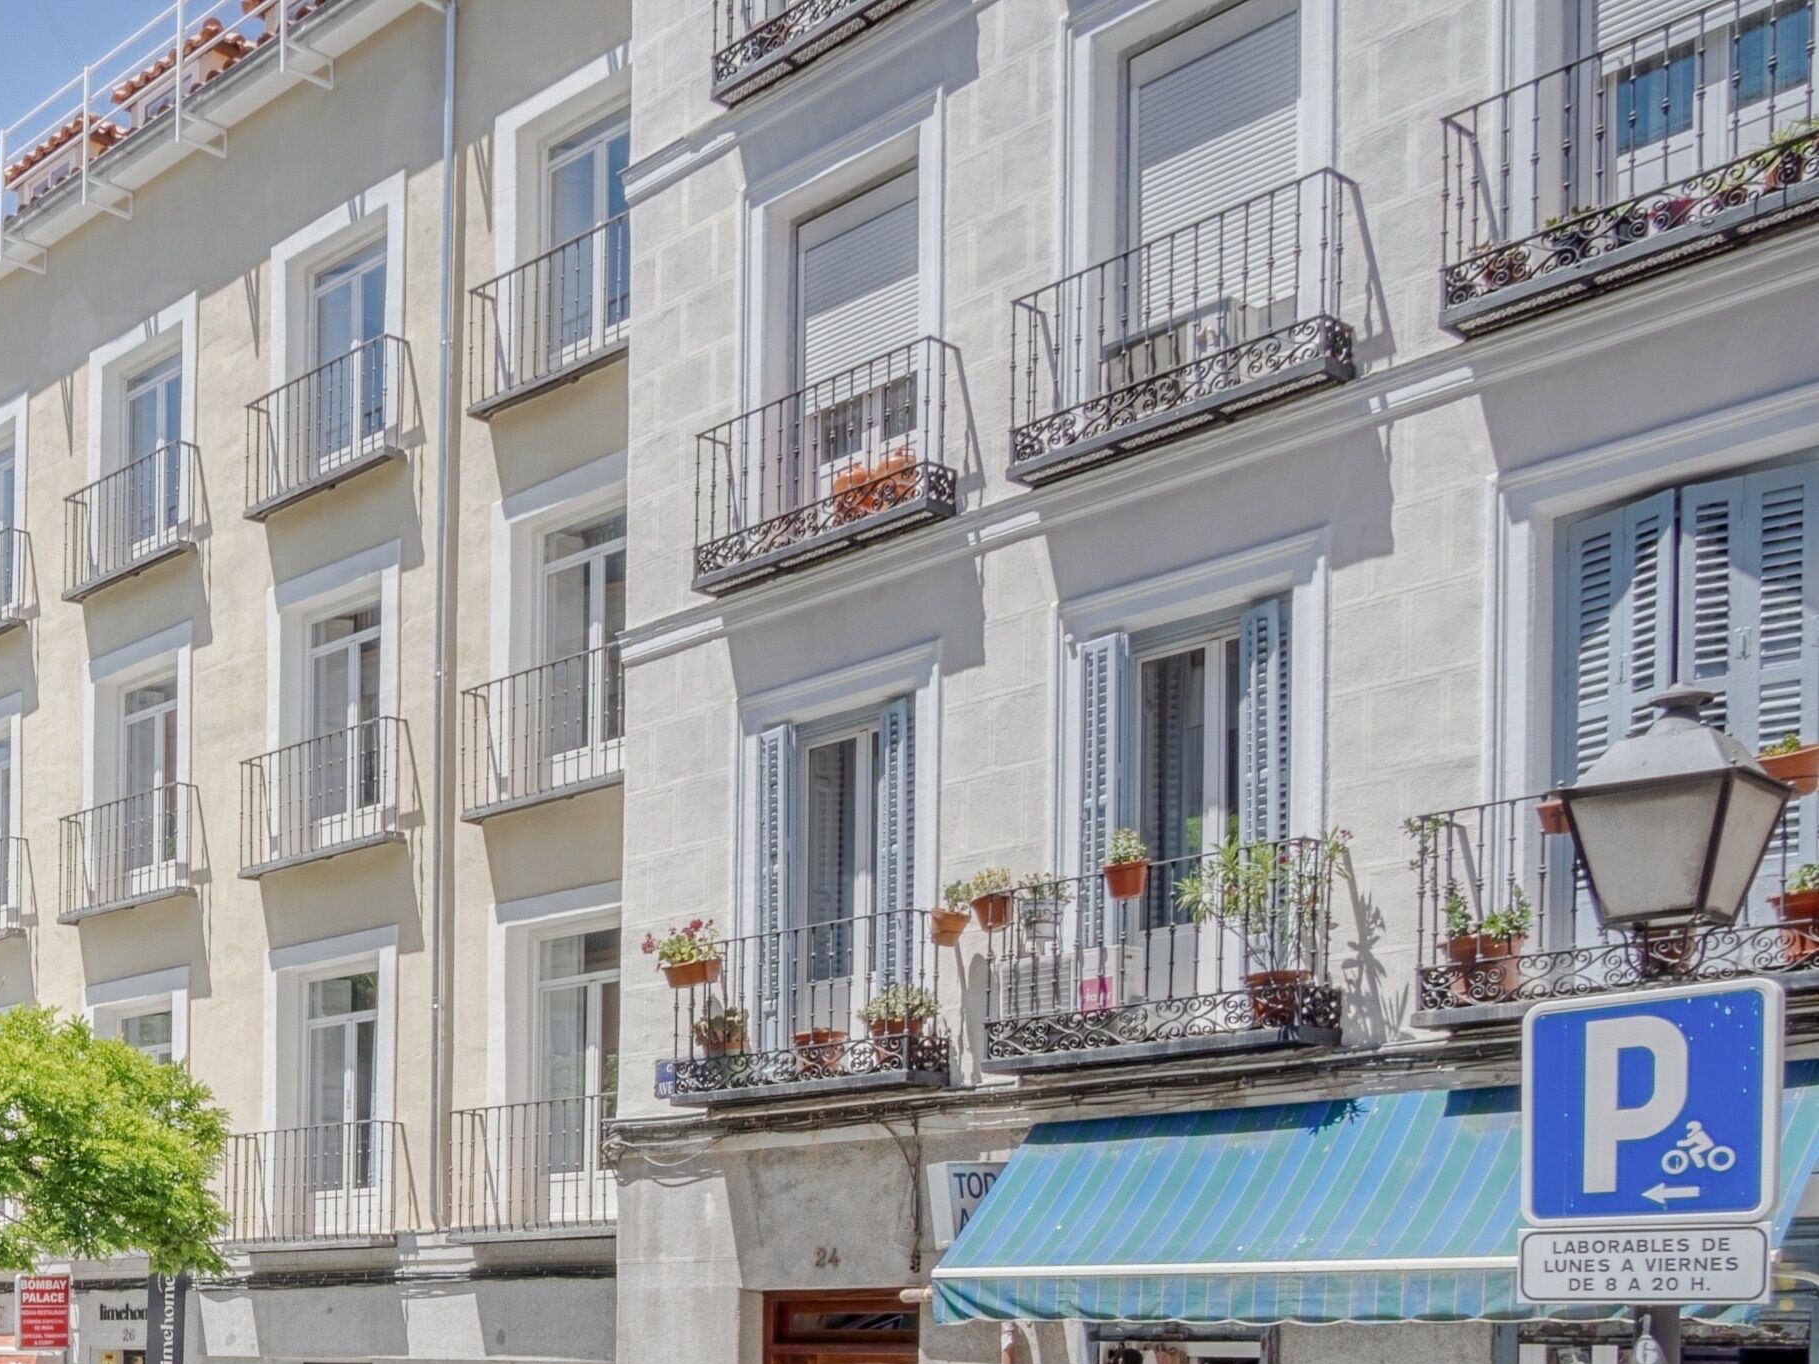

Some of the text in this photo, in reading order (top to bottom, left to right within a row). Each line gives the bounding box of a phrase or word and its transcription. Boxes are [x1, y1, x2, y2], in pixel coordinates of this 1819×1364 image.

[1583, 1015, 1689, 1194] P
[1553, 1237, 1730, 1255] LABORABLES DE
[815, 1247, 841, 1268] 24
[1544, 1256, 1739, 1273] LUNES A VIERNES
[21, 1280, 67, 1291] BOMBAY
[1569, 1277, 1711, 1291] DE 8 A 20 H.
[22, 1292, 65, 1303] PALACE
[122, 1329, 135, 1342] 26
